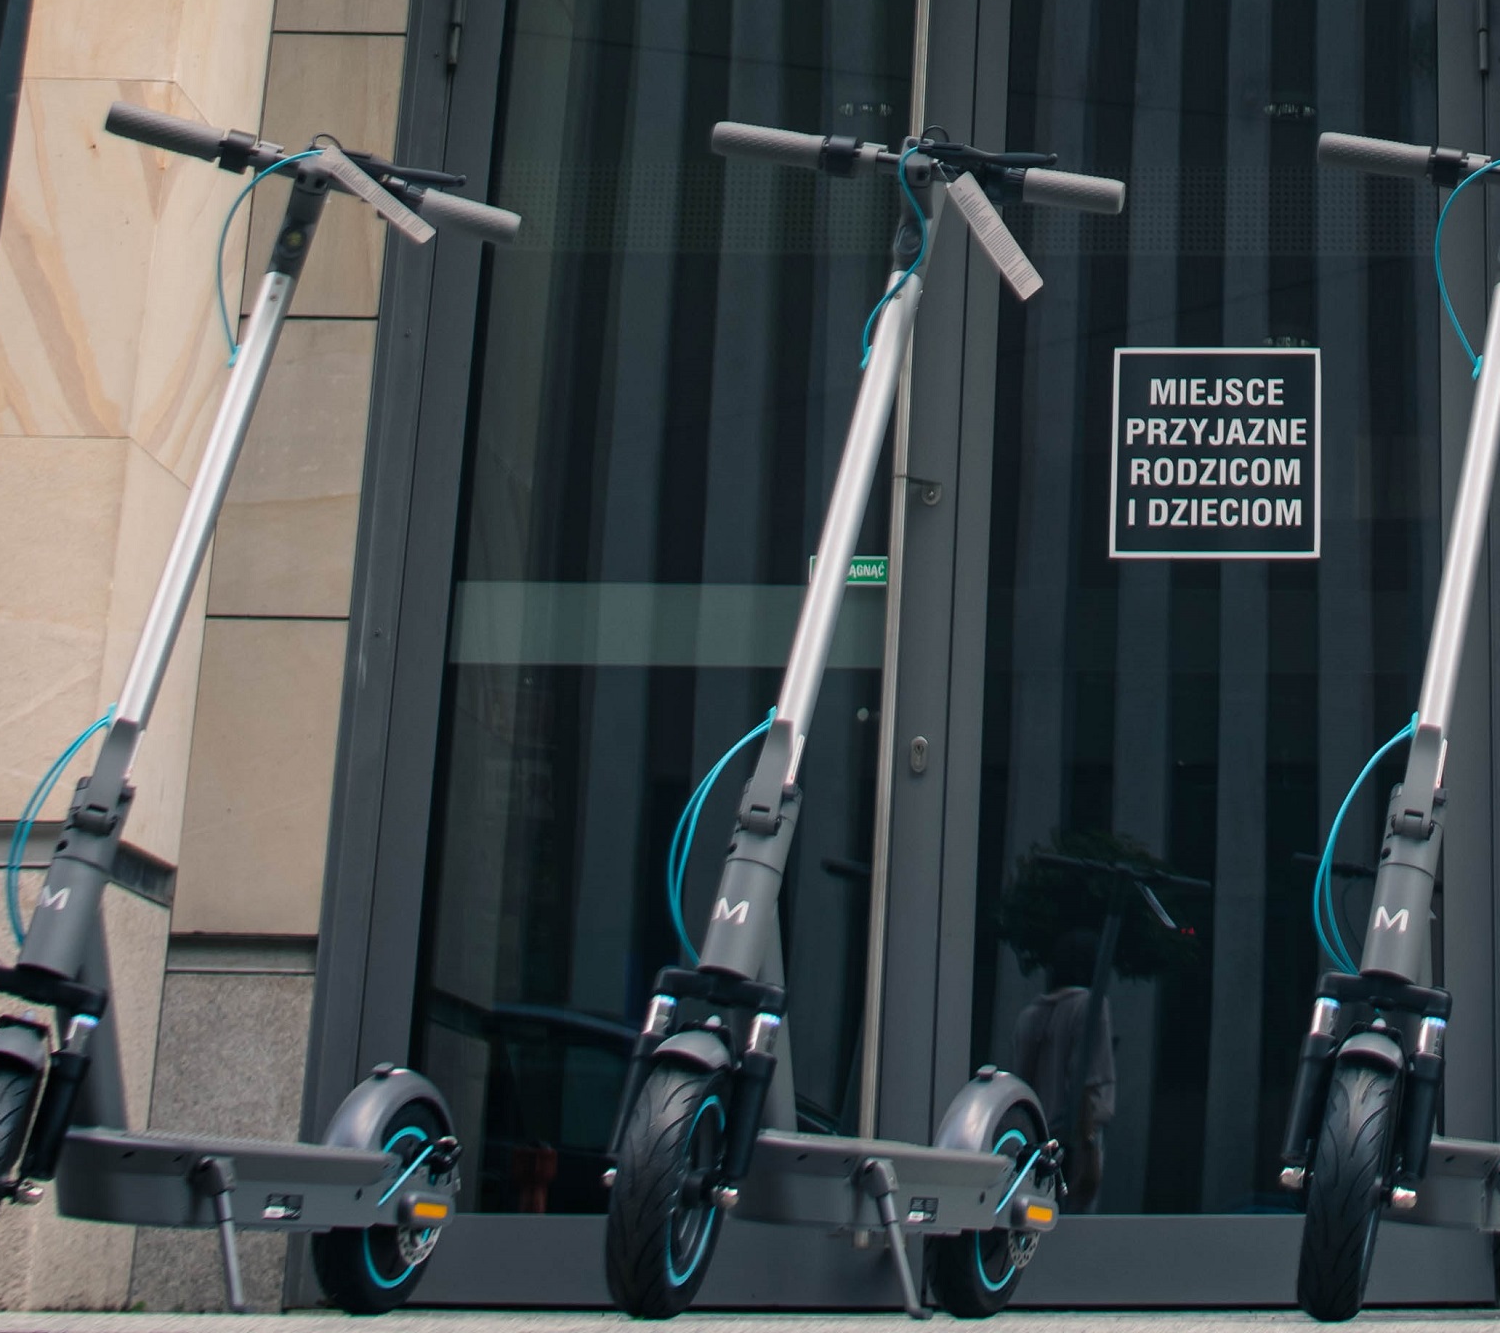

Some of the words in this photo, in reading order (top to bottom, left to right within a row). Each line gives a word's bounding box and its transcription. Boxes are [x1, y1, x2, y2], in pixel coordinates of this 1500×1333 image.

[1150, 378, 1284, 406] MIEJSCE
[1126, 418, 1307, 446] PRZYJAZNE
[1130, 457, 1301, 486] RODZICOM
[1127, 498, 1136, 526] I
[1148, 497, 1302, 526] DZIECIOM
[849, 561, 885, 579] ĄGNĄĆ
[711, 897, 749, 923] M
[1374, 906, 1409, 932] M
